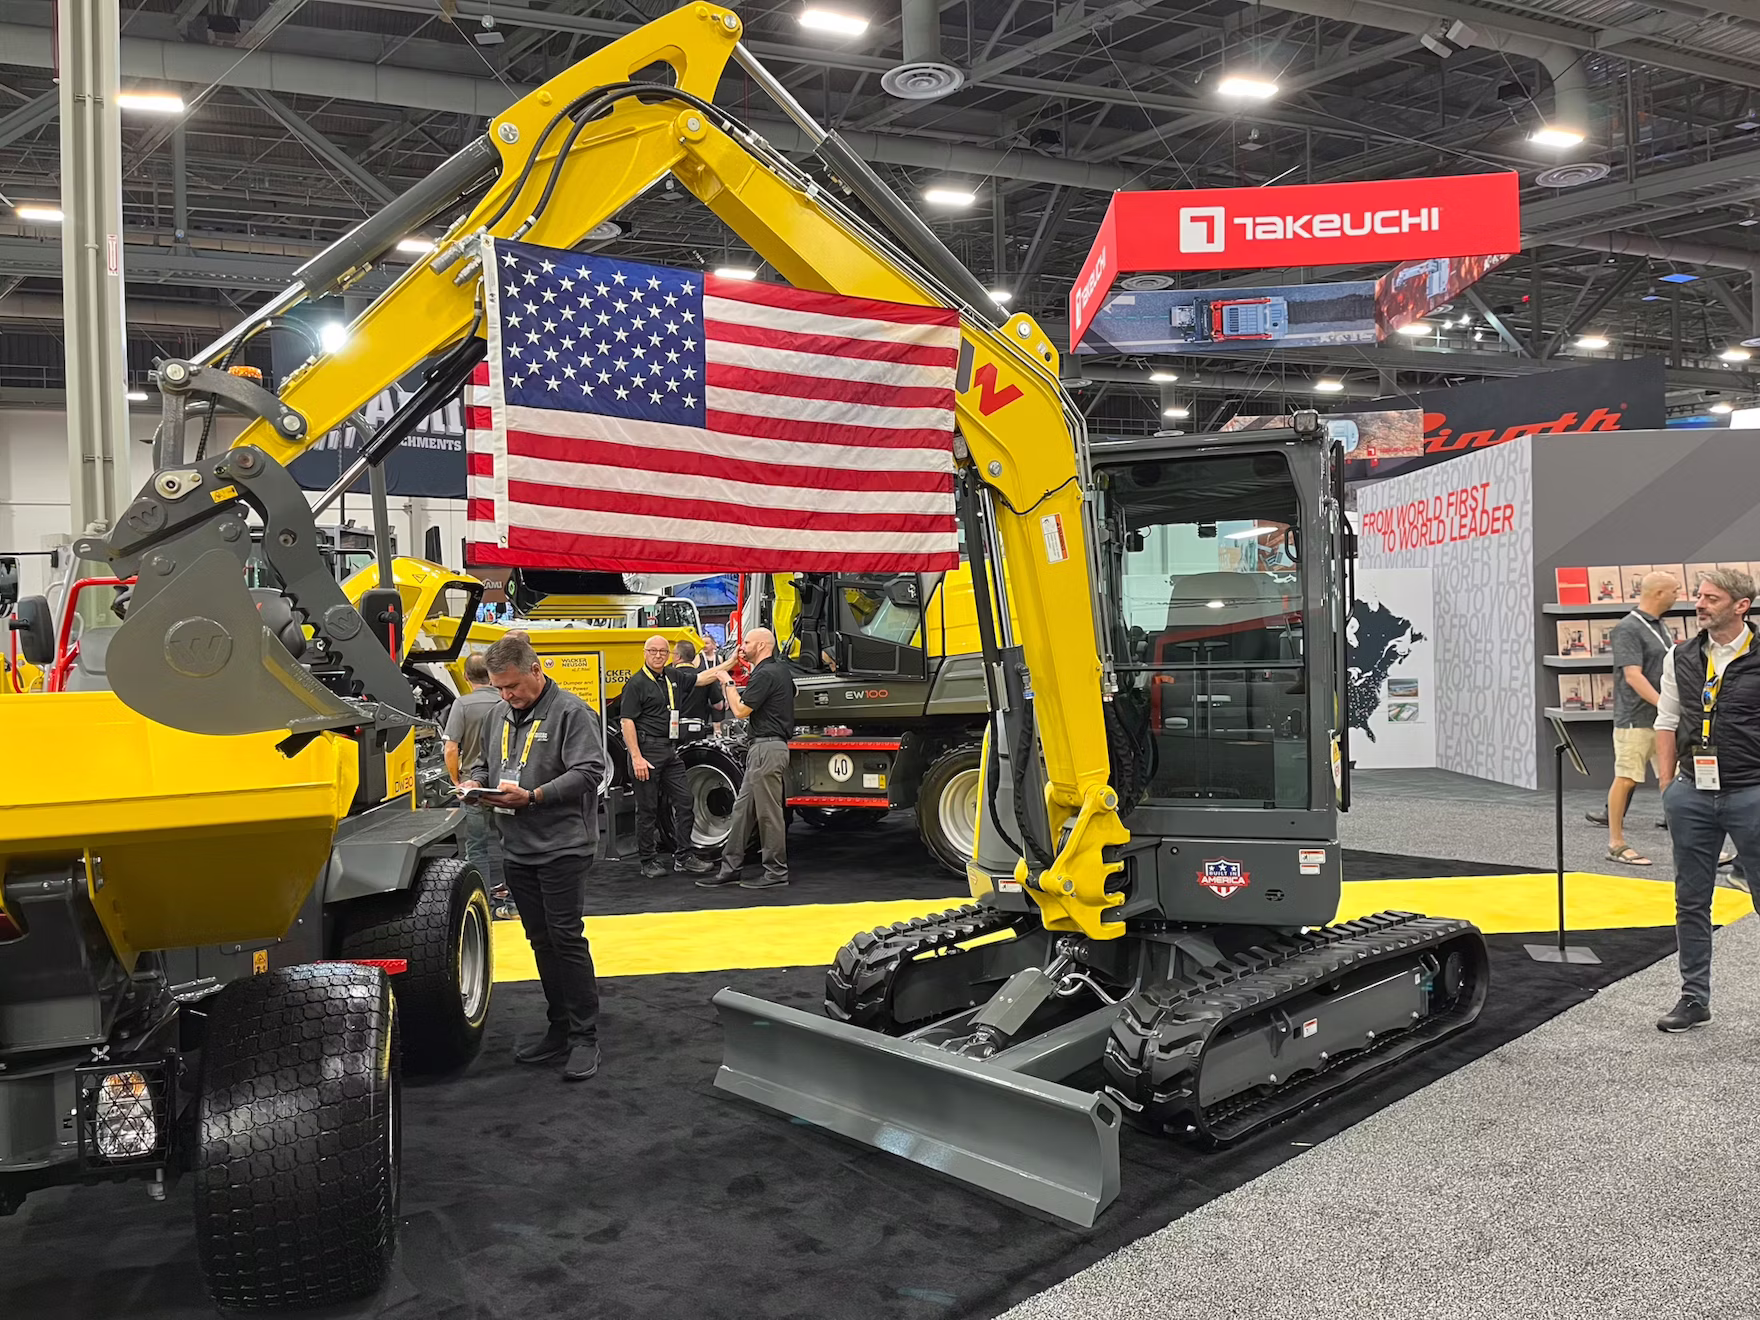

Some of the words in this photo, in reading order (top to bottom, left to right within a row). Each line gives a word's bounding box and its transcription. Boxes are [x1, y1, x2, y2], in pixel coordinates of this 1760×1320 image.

[1233, 206, 1440, 241] TAKEUCHI
[401, 436, 462, 451] CHMENTS
[1478, 445, 1528, 481] WORL
[1362, 507, 1394, 536] FROM
[1397, 495, 1443, 529] WORLD
[1446, 481, 1490, 518] FIRST
[1382, 529, 1396, 554] TO
[1400, 518, 1446, 551] WORLD
[1450, 504, 1514, 543] LEADER
[1497, 527, 1533, 560] FRO
[1500, 638, 1533, 667] FRO
[845, 689, 889, 700] EW100
[1492, 688, 1533, 720] WOR
[834, 758, 848, 776] 40
[1501, 745, 1536, 779] FRO
[1200, 876, 1246, 885] AMERICA
